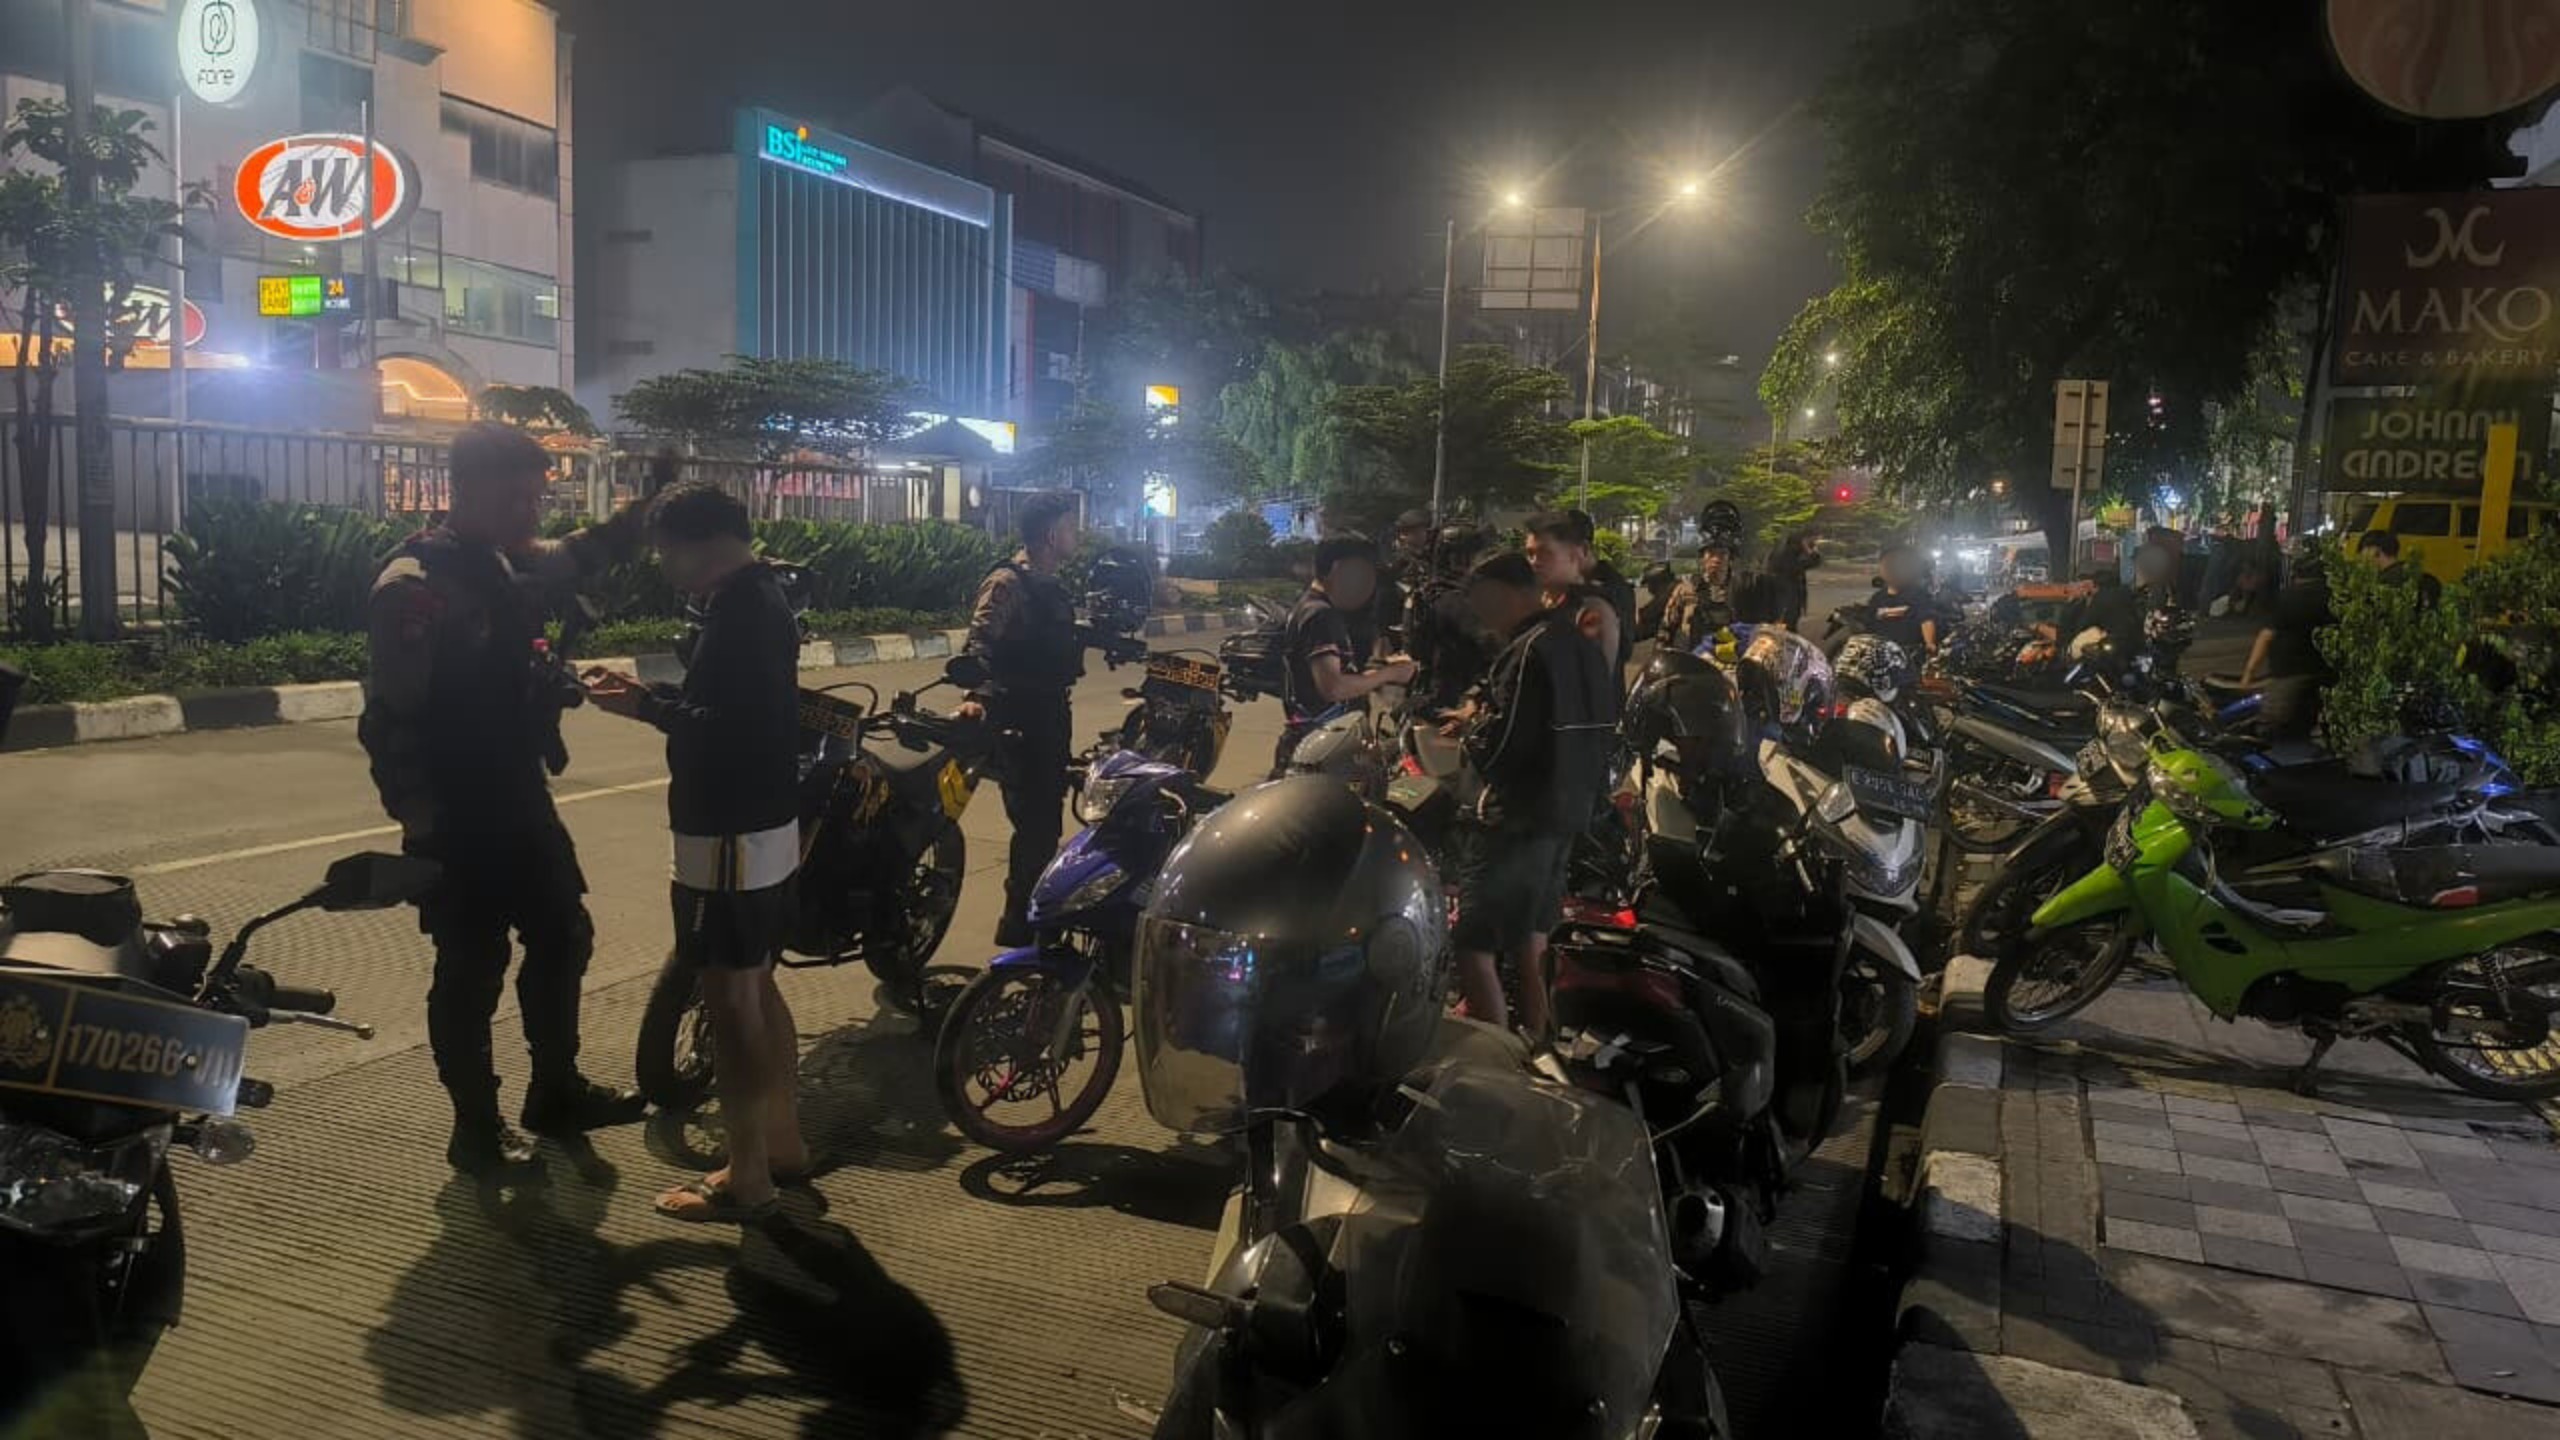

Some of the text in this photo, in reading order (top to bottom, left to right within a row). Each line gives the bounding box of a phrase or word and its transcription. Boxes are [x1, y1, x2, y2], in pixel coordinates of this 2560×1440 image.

[260, 158, 366, 219] A&W
[327, 279, 345, 297] 24
[2352, 287, 2551, 342] MAKO
[2345, 349, 2545, 367] CAKE & BAKERY
